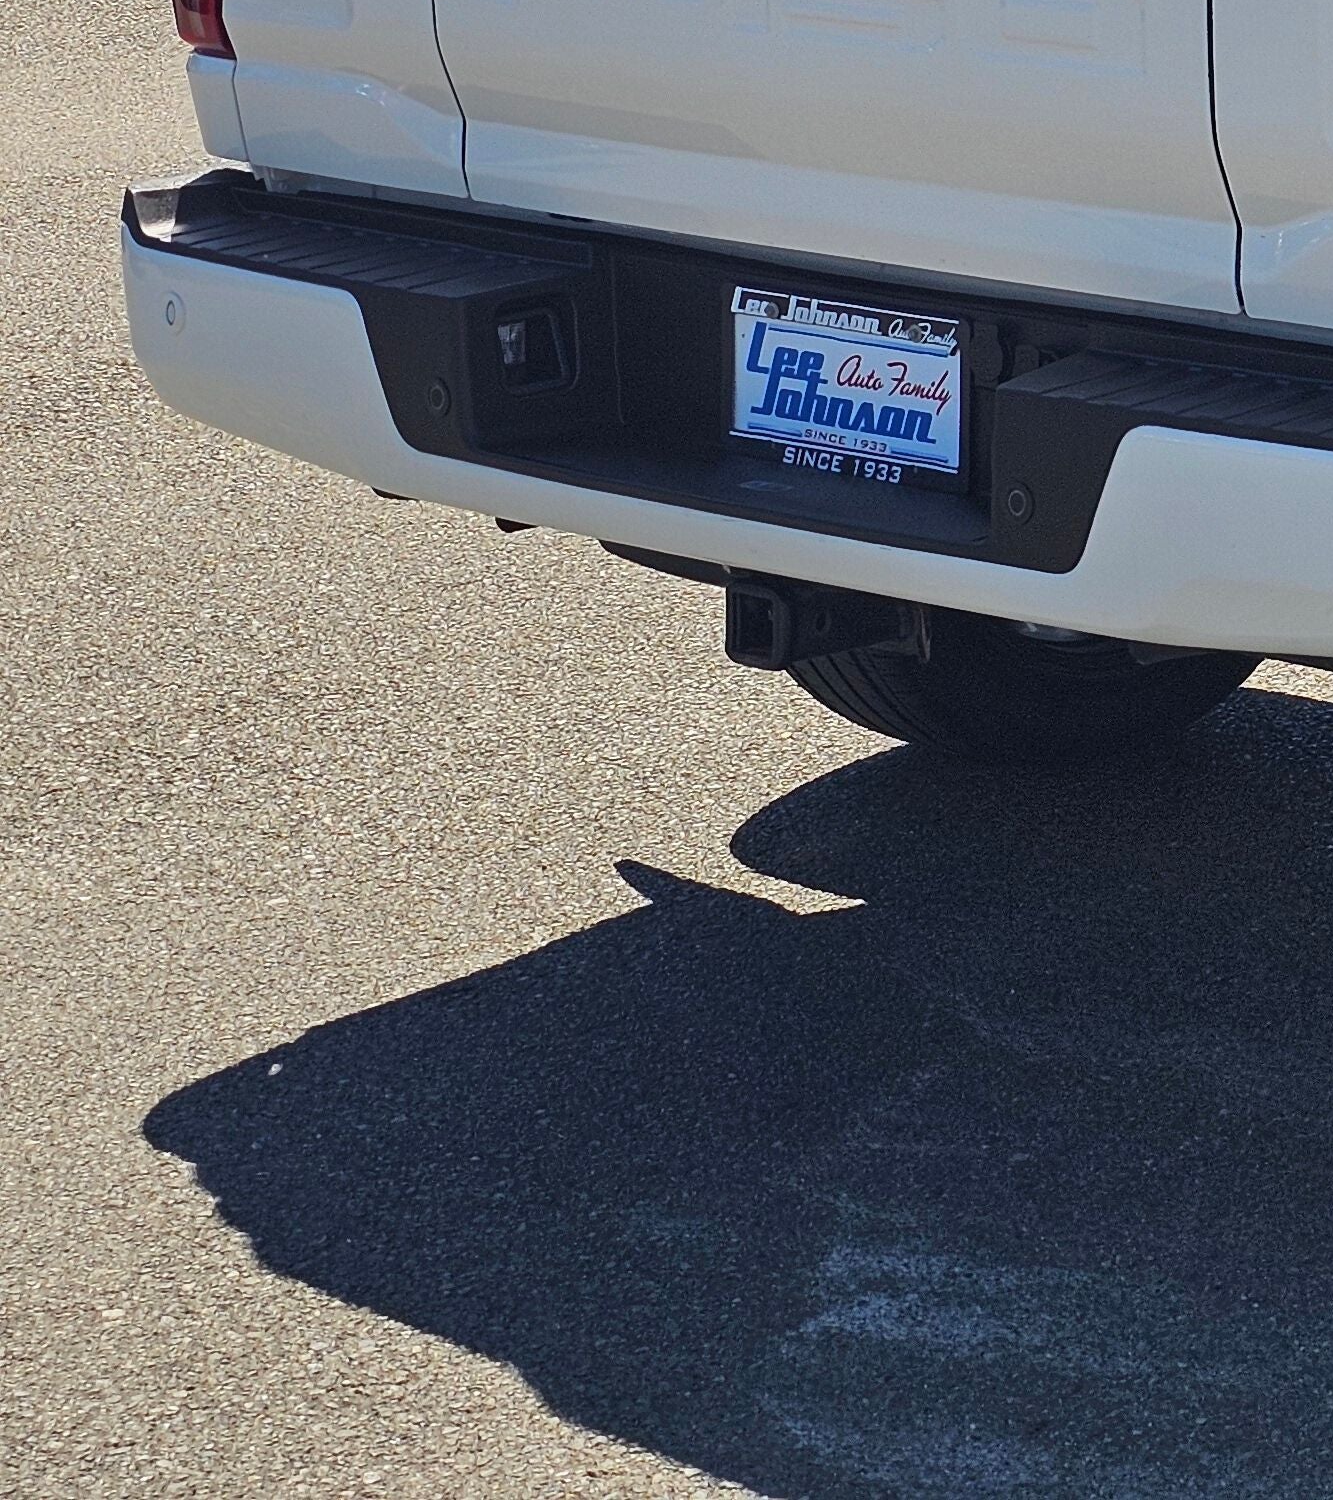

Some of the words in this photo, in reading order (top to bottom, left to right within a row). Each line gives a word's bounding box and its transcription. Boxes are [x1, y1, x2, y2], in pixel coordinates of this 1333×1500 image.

[781, 295, 882, 336] Johnson
[746, 321, 828, 381] Lee
[836, 355, 884, 391] Auto
[886, 361, 952, 416] Family
[750, 372, 937, 445] Johnson
[804, 429, 847, 446] SINCE
[853, 436, 888, 453] 1933
[782, 445, 844, 474] SINCE
[853, 460, 903, 484] 1933
